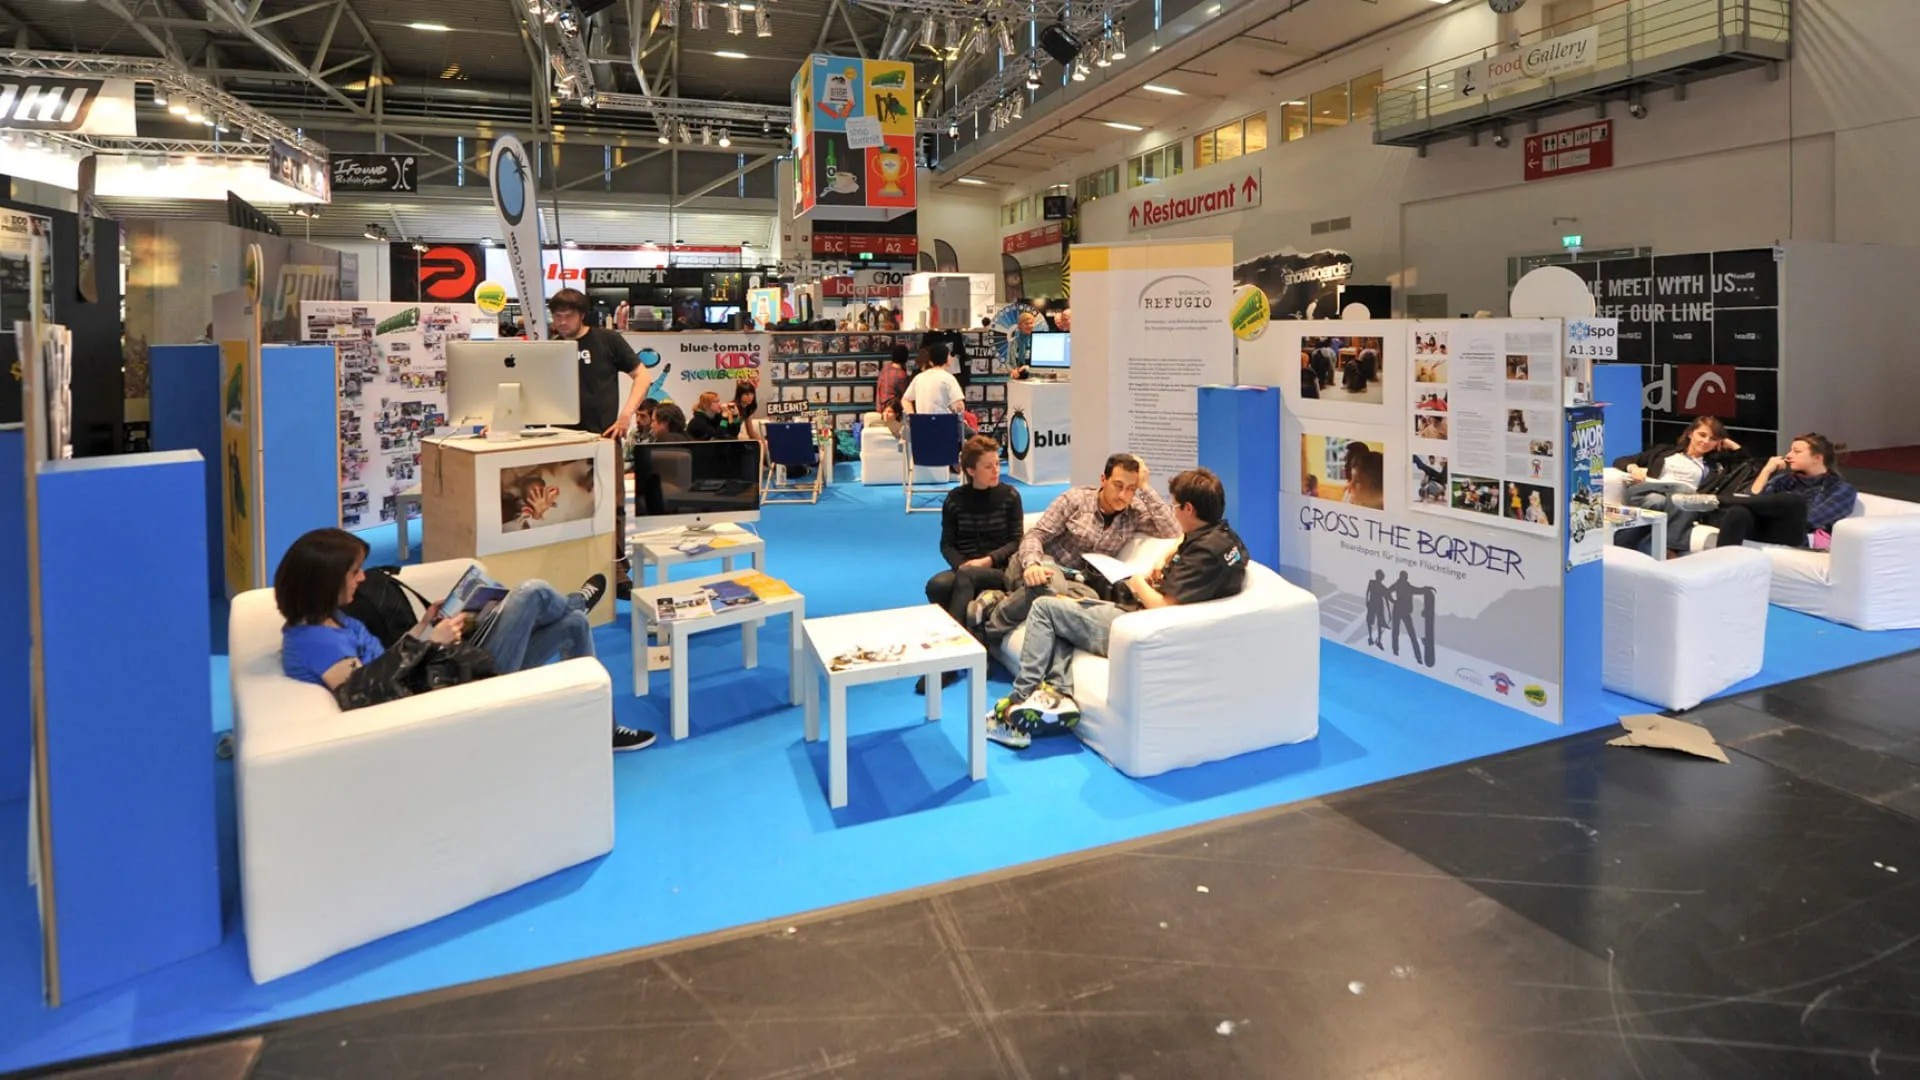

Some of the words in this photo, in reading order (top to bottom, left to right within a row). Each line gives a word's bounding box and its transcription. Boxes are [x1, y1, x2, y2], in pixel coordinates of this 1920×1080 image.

[1488, 54, 1522, 78] Food
[1527, 39, 1587, 67] Gallery
[1142, 183, 1236, 226] Restaurant
[590, 268, 652, 284] TECHNINE
[1283, 261, 1353, 286] snowboarder
[1608, 276, 1653, 297] MEET
[1657, 273, 1704, 296] WITH
[1144, 297, 1212, 309] REFUGIO
[1630, 303, 1665, 323] OUR
[1671, 301, 1713, 323] LINE
[680, 342, 761, 353] blue-tomato
[1569, 344, 1614, 356] A1.319
[715, 352, 761, 369] KIDS
[1299, 505, 1360, 540] CROSS
[1364, 518, 1411, 551] THE
[1416, 529, 1526, 581] BORDER
